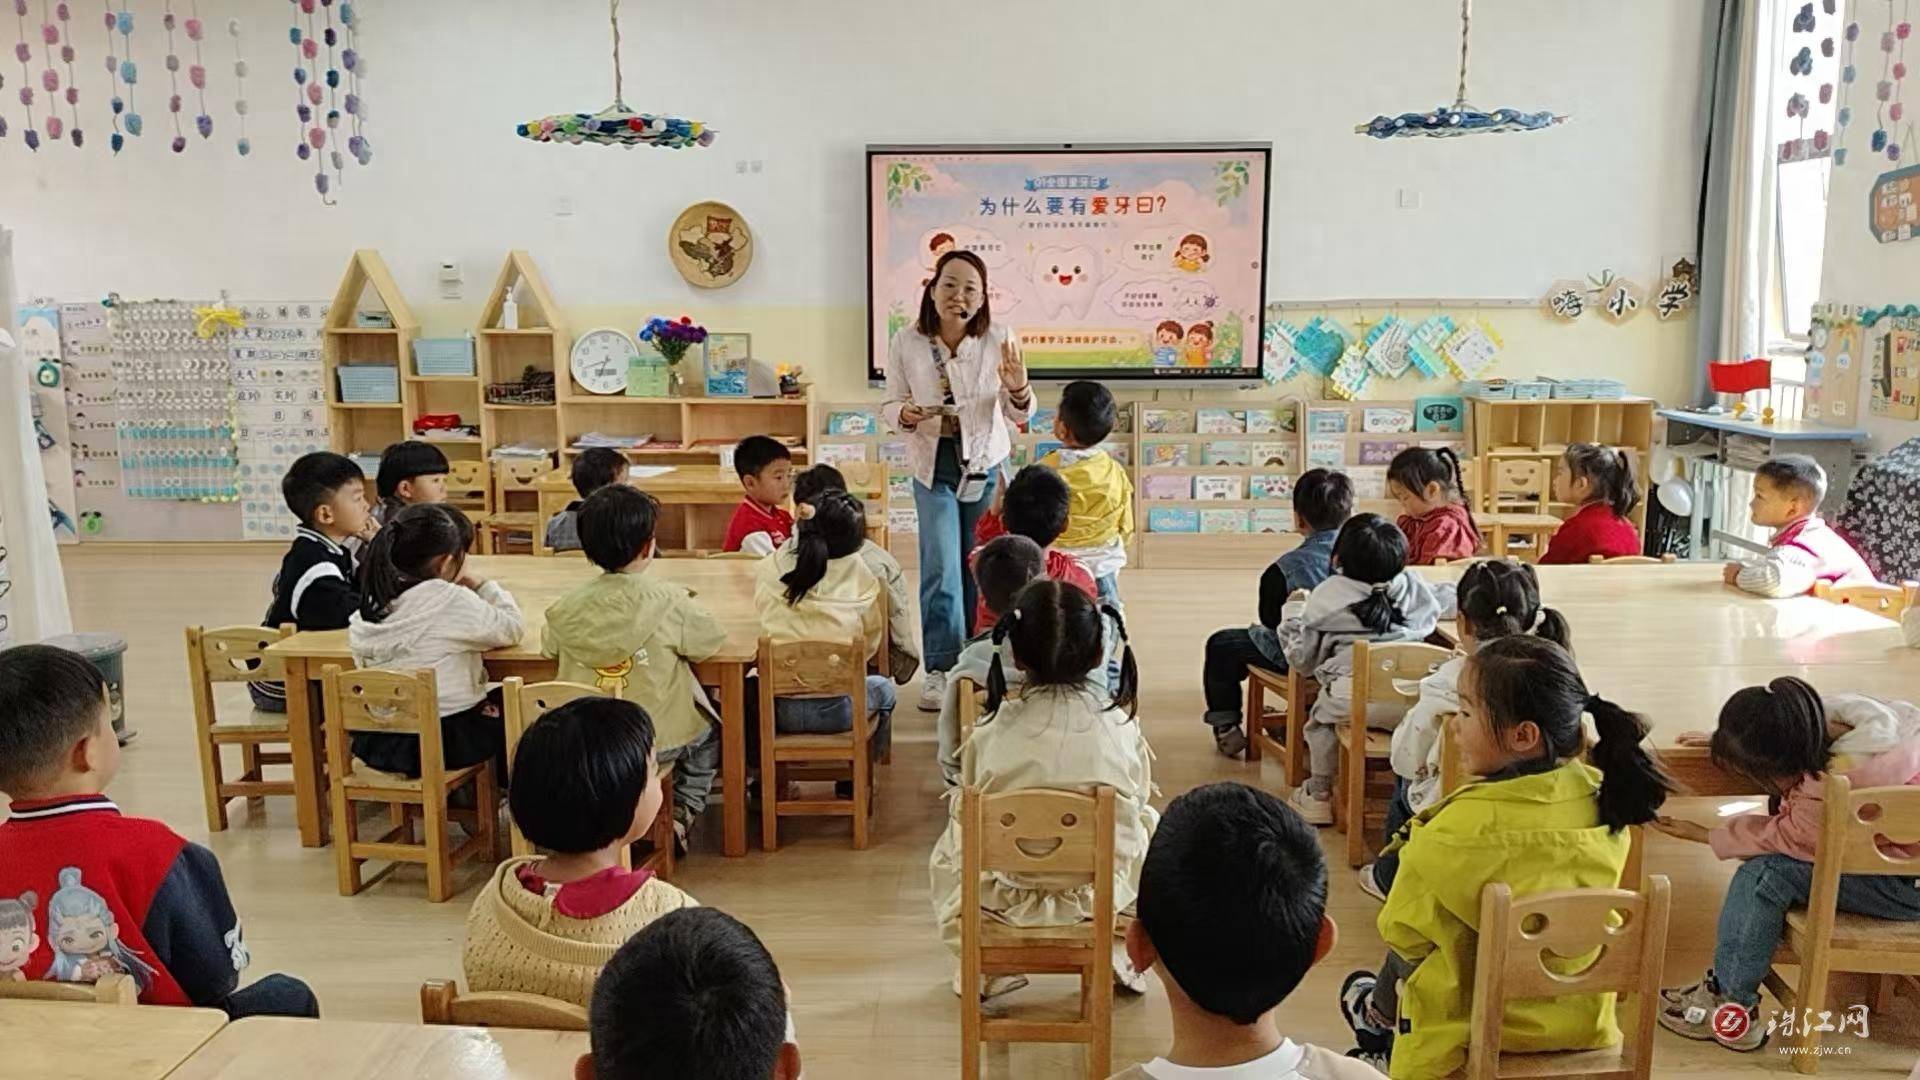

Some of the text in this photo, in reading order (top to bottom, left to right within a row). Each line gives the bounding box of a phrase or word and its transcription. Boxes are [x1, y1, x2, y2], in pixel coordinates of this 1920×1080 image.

[980, 196, 1167, 216] 为什么要有爱牙日?
